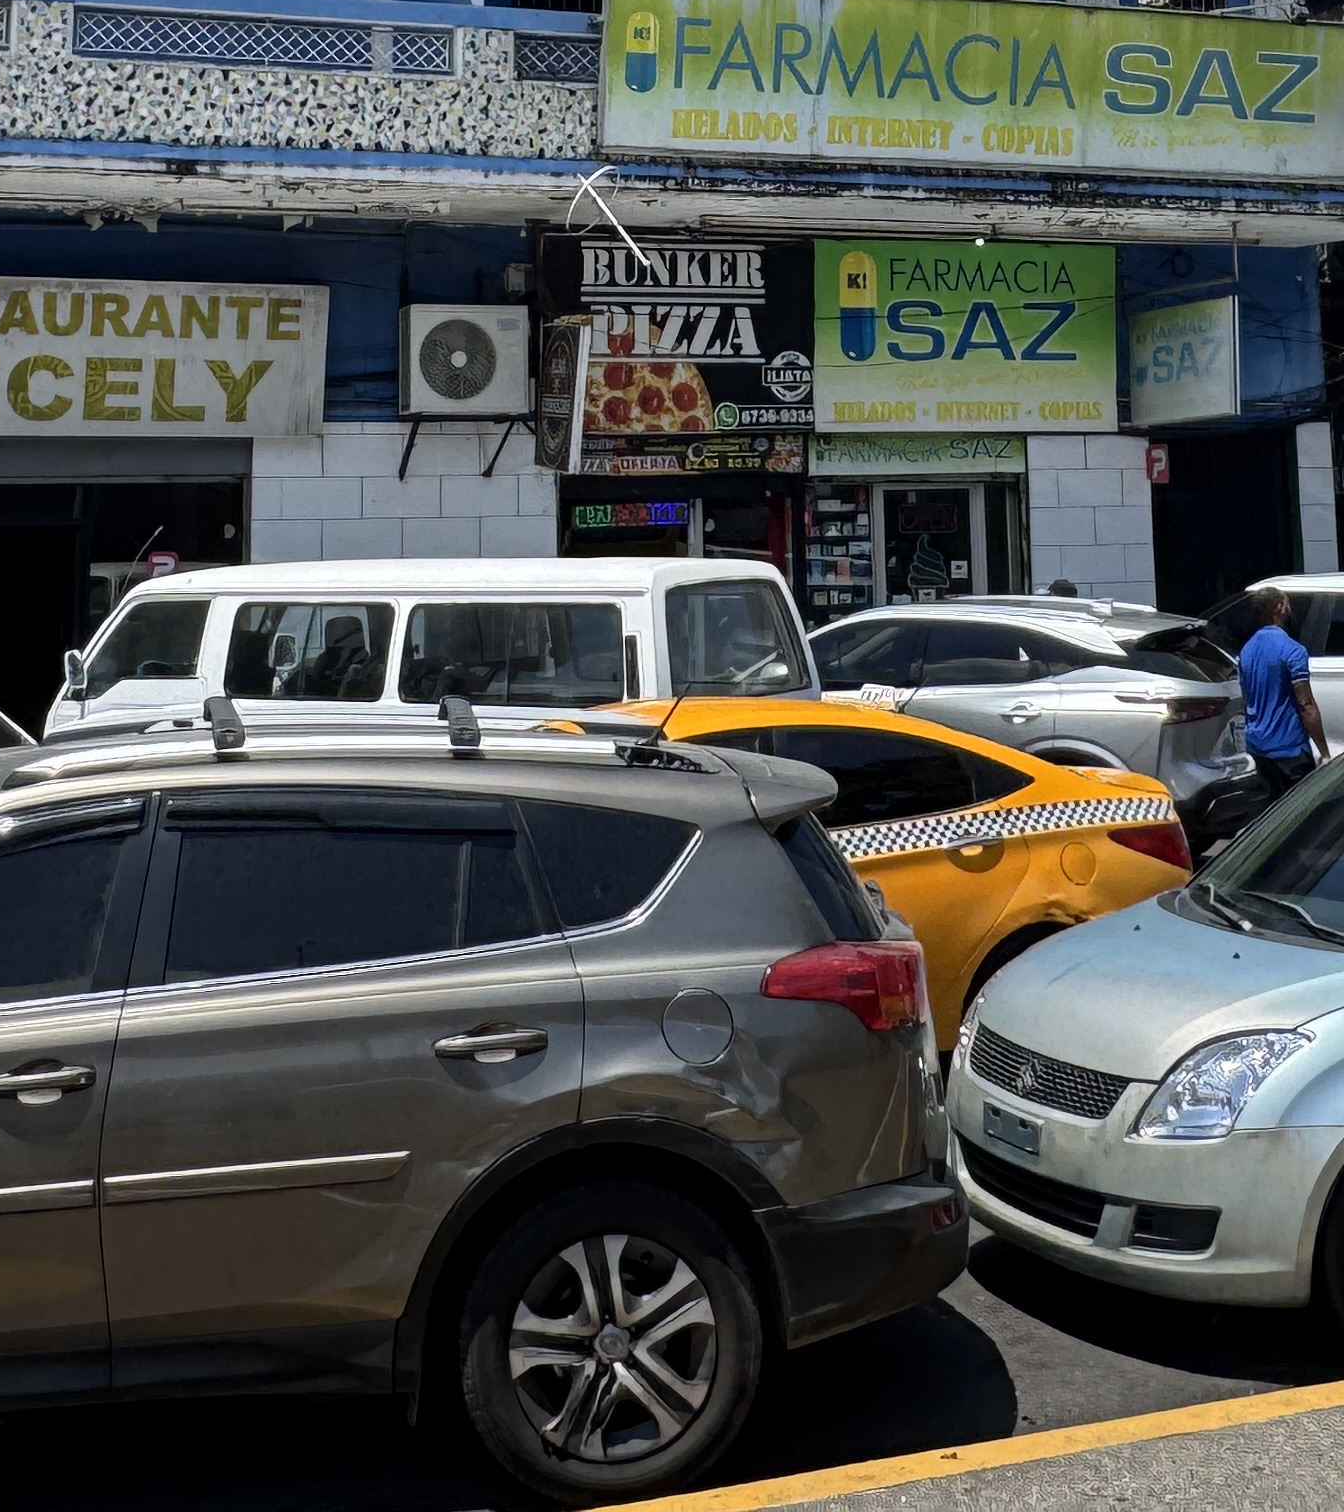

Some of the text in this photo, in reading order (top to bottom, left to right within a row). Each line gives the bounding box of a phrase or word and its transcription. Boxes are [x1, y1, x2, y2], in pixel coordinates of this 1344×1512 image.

[673, 16, 1320, 123] FARMACIA SAZ
[672, 109, 797, 142] HELADOS
[826, 115, 954, 150] INTERNET
[982, 123, 1074, 156] COPIAS
[581, 248, 765, 287] BUNKER
[889, 259, 1075, 294] FARMACIA
[590, 305, 762, 355] PIZZA
[886, 300, 1078, 361] SAZ
[834, 401, 1103, 423] HELADOS INTERNET COPIAS
[824, 439, 1015, 463] FARMACIA SAZ
